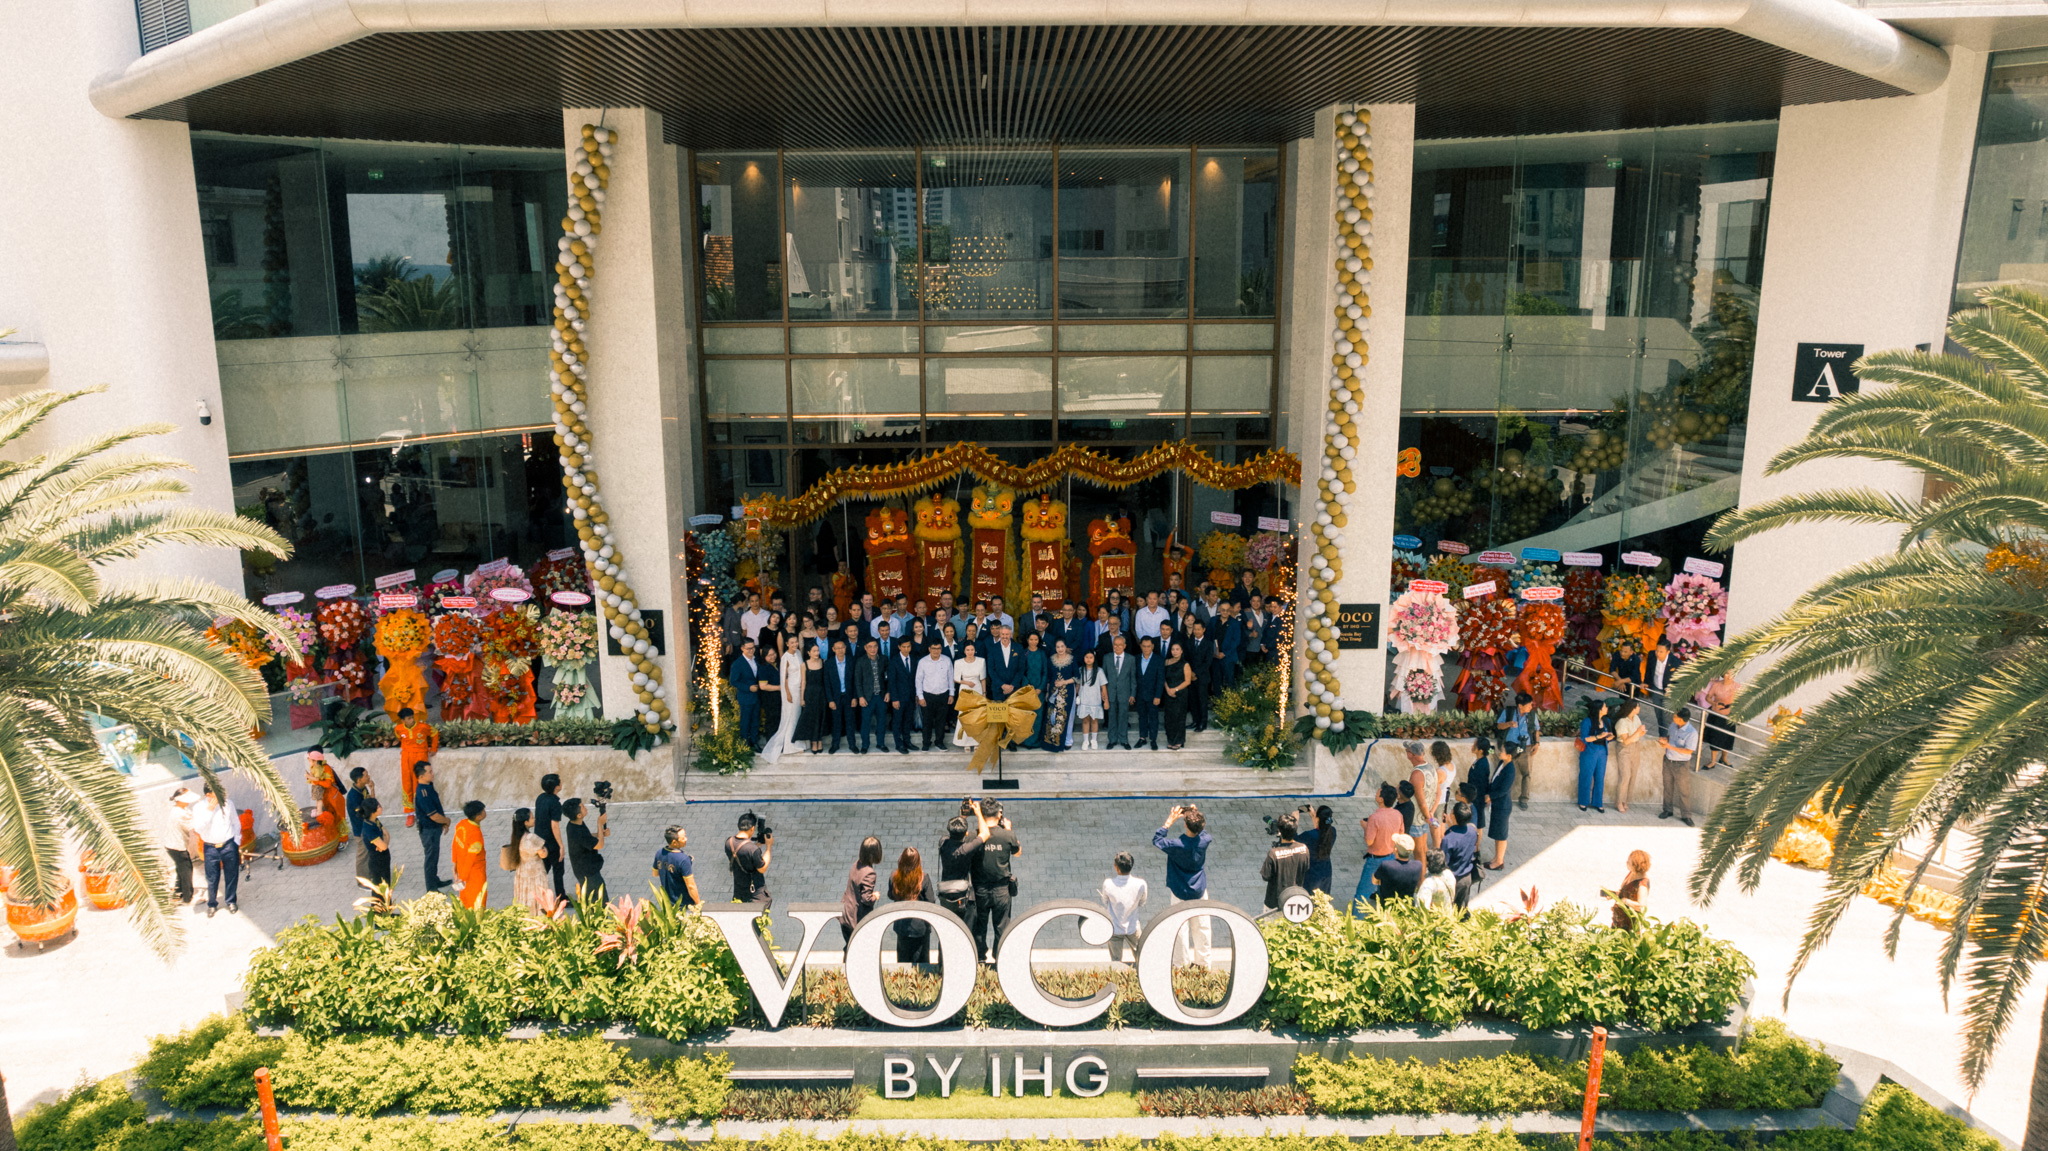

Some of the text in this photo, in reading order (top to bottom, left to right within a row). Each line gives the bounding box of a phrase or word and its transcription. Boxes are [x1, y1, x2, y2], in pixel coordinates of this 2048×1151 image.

[1813, 348, 1847, 358] Tower
[1806, 361, 1843, 398] A
[929, 546, 951, 561] VẠN
[1105, 566, 1131, 578] KHAI
[1339, 612, 1372, 623] OCO
[701, 903, 1310, 1028] VOCO TM
[884, 1055, 1110, 1099] BY IHG
